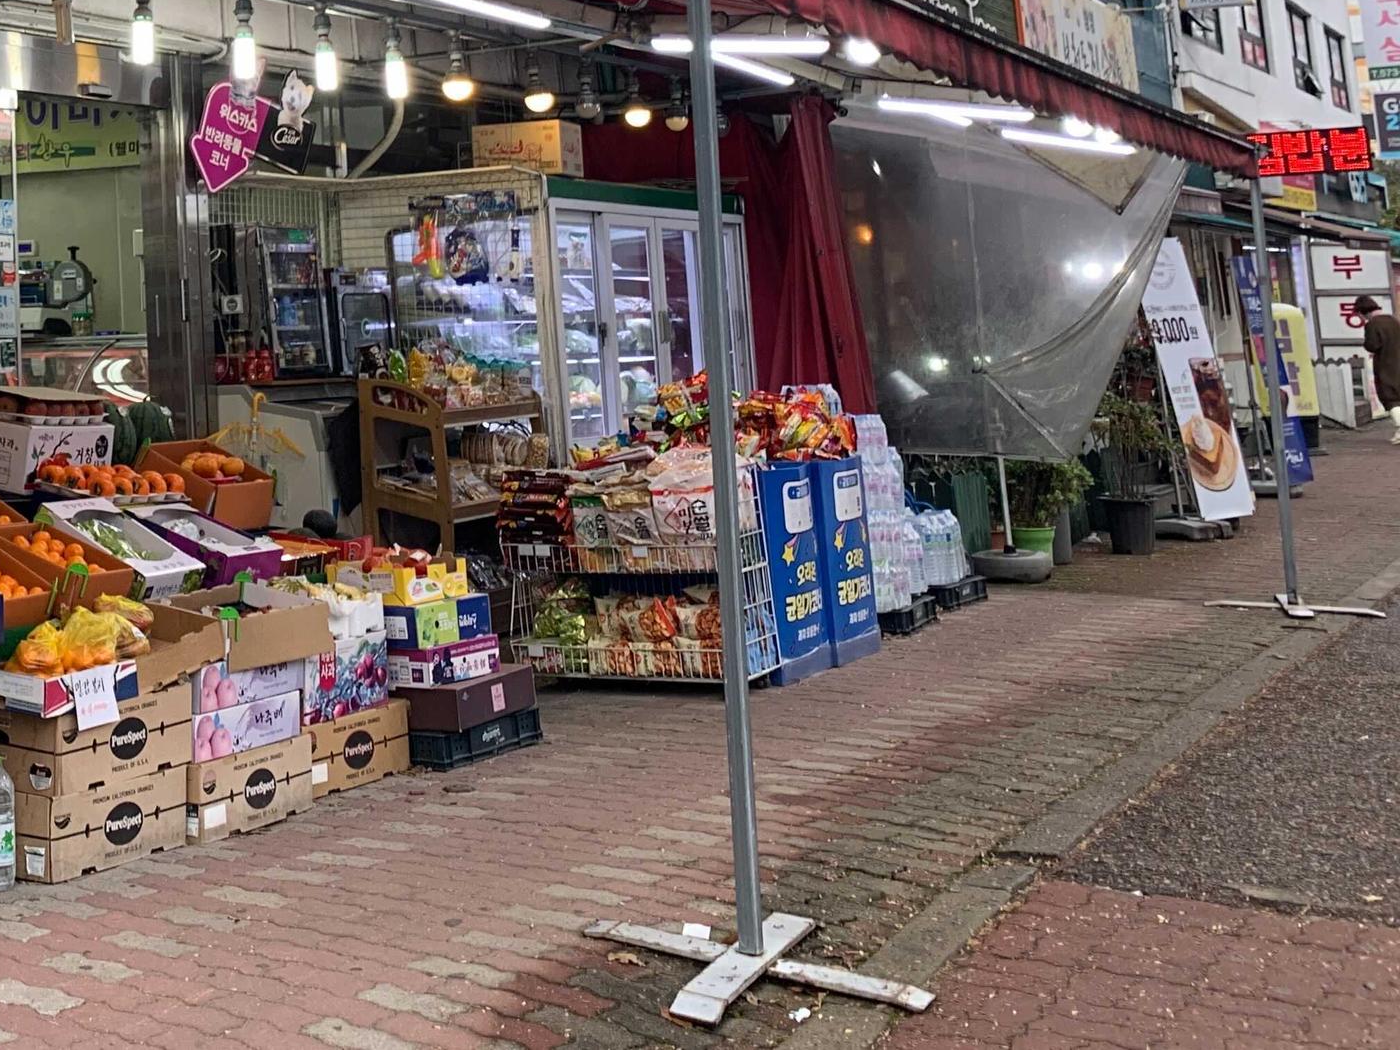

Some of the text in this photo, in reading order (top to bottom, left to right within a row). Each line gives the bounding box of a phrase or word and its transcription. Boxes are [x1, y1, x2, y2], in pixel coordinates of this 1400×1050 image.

[219, 103, 257, 133] 위스카스
[205, 125, 242, 155] 반려동물
[209, 150, 230, 171] 코너
[74, 448, 94, 464] 거창
[846, 548, 864, 573] 오리온
[797, 560, 817, 587] 오리온
[320, 663, 335, 679] 사과
[255, 700, 286, 726] 나주배
[111, 729, 147, 748] PureSpect
[344, 742, 374, 758] PureSpect
[245, 780, 276, 796] PureSpect
[106, 814, 143, 834] PureSpect
